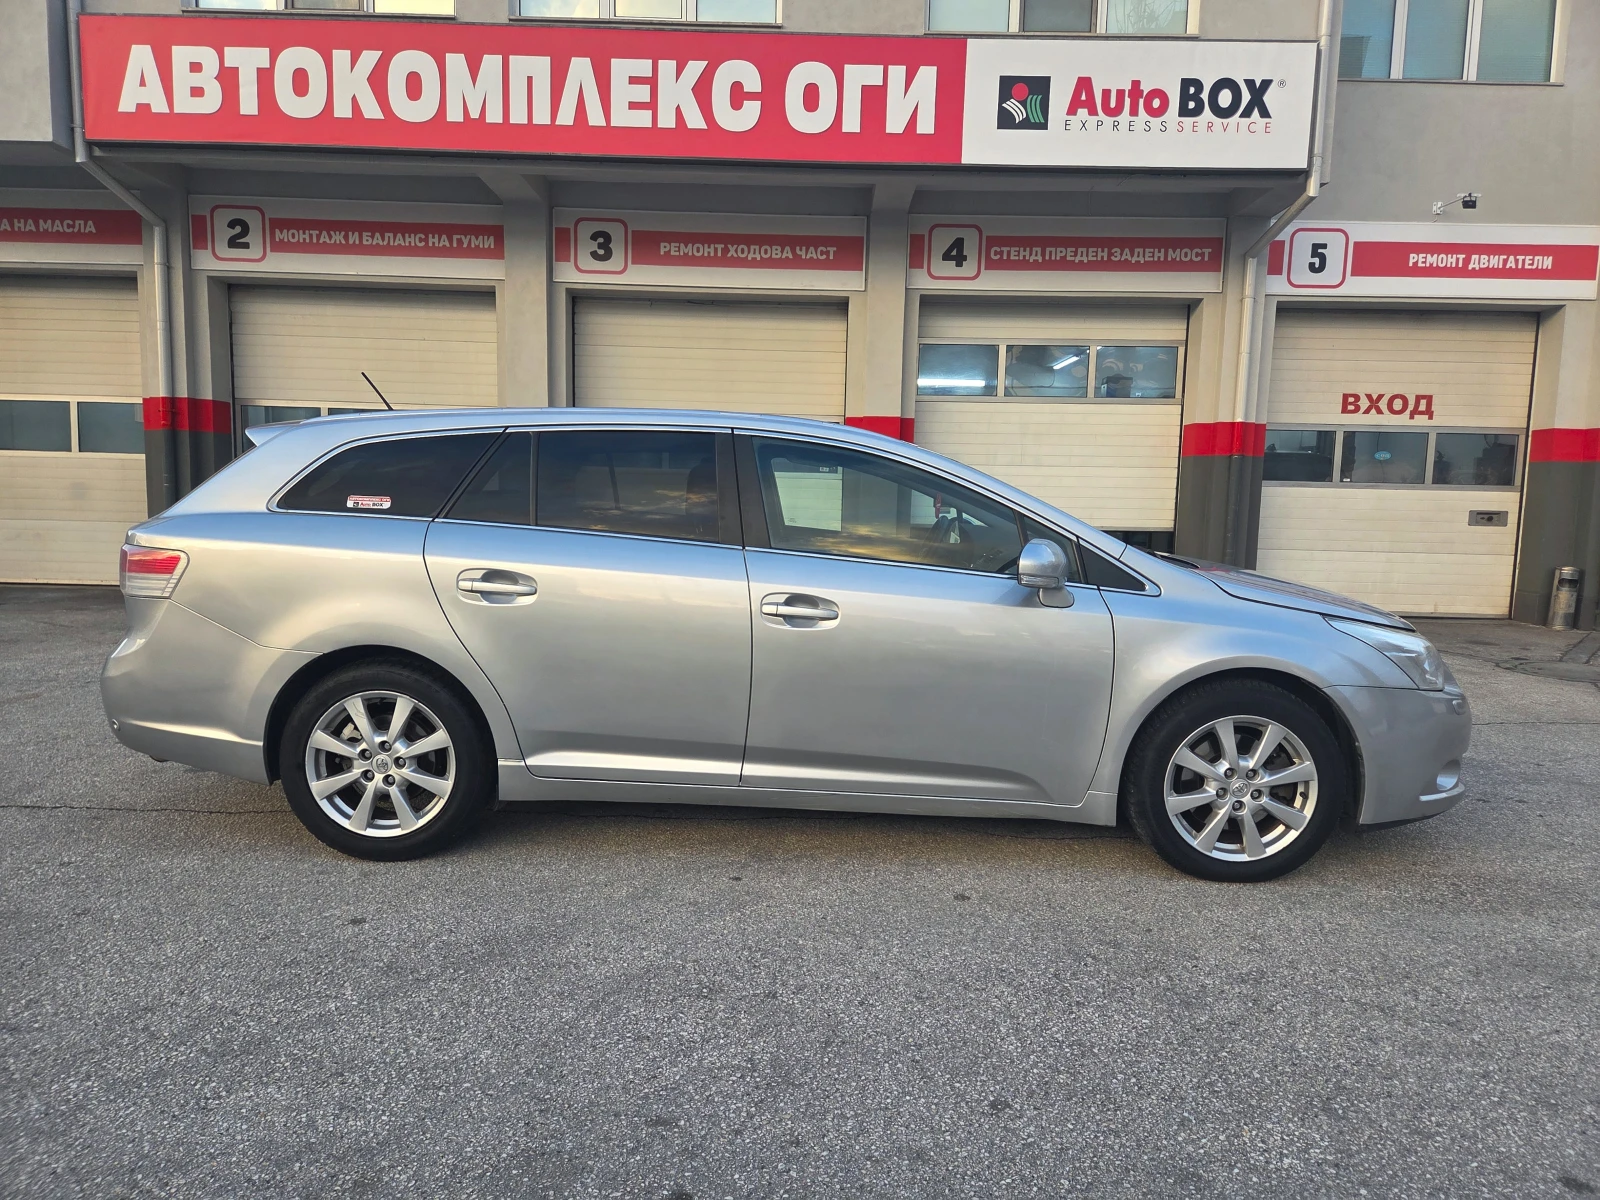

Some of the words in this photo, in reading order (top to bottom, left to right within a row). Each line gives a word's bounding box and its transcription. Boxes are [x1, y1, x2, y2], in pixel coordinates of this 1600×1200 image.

[117, 44, 763, 133] АВТОКОМПЛЕКС
[784, 61, 938, 135] ОГИ
[1065, 76, 1170, 119] Auto
[1177, 77, 1274, 120] BOX
[1064, 119, 1168, 133] EXPRESS
[1176, 121, 1272, 134] SERVICE
[13, 218, 37, 232] НА
[39, 219, 97, 233] МАСЛА
[226, 217, 251, 250] 2
[275, 229, 346, 244] МОНТАЖ
[349, 231, 360, 245] И
[362, 231, 426, 247] БАЛАНС
[428, 233, 450, 248] НА
[452, 234, 495, 249] ГУМИ
[589, 229, 614, 262] 3
[660, 242, 724, 258] РЕМОНТ
[727, 244, 793, 261] ХОДОВА
[796, 246, 837, 260] ЧАСТ
[941, 236, 968, 268] 4
[990, 246, 1042, 262] СТЕНД
[1045, 247, 1108, 263] ПРЕДЕН
[1111, 247, 1165, 263] ЗАДЕН
[1167, 248, 1212, 262] МОСТ
[1308, 242, 1328, 274] 5
[1408, 253, 1466, 268] РЕМОНТ
[1468, 254, 1553, 270] ДВИГАТЕЛИ
[1341, 393, 1434, 420] ВХОД
